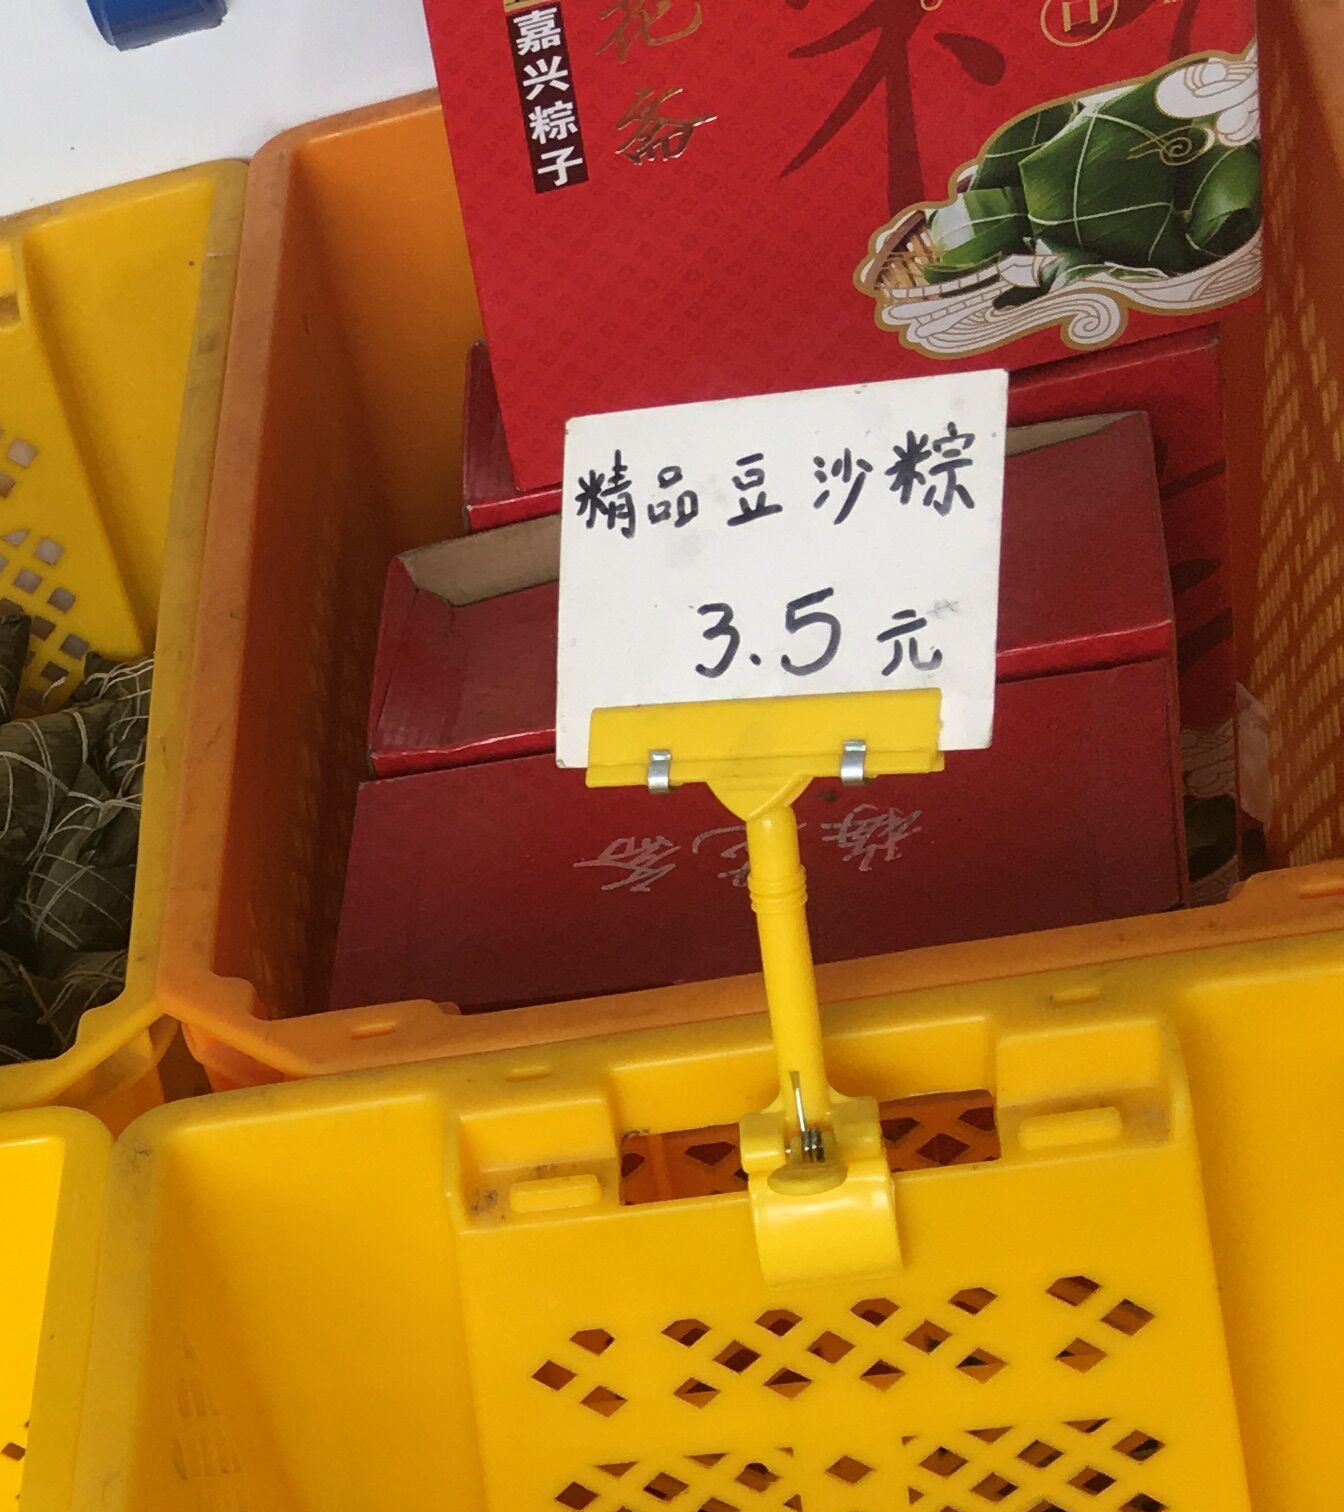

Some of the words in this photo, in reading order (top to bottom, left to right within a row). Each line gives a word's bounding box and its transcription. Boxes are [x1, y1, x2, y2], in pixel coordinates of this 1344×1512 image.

[513, 7, 583, 187] 嘉兴粽子
[575, 422, 976, 538] 精品豆沙粽
[694, 587, 943, 678] 3.5元
